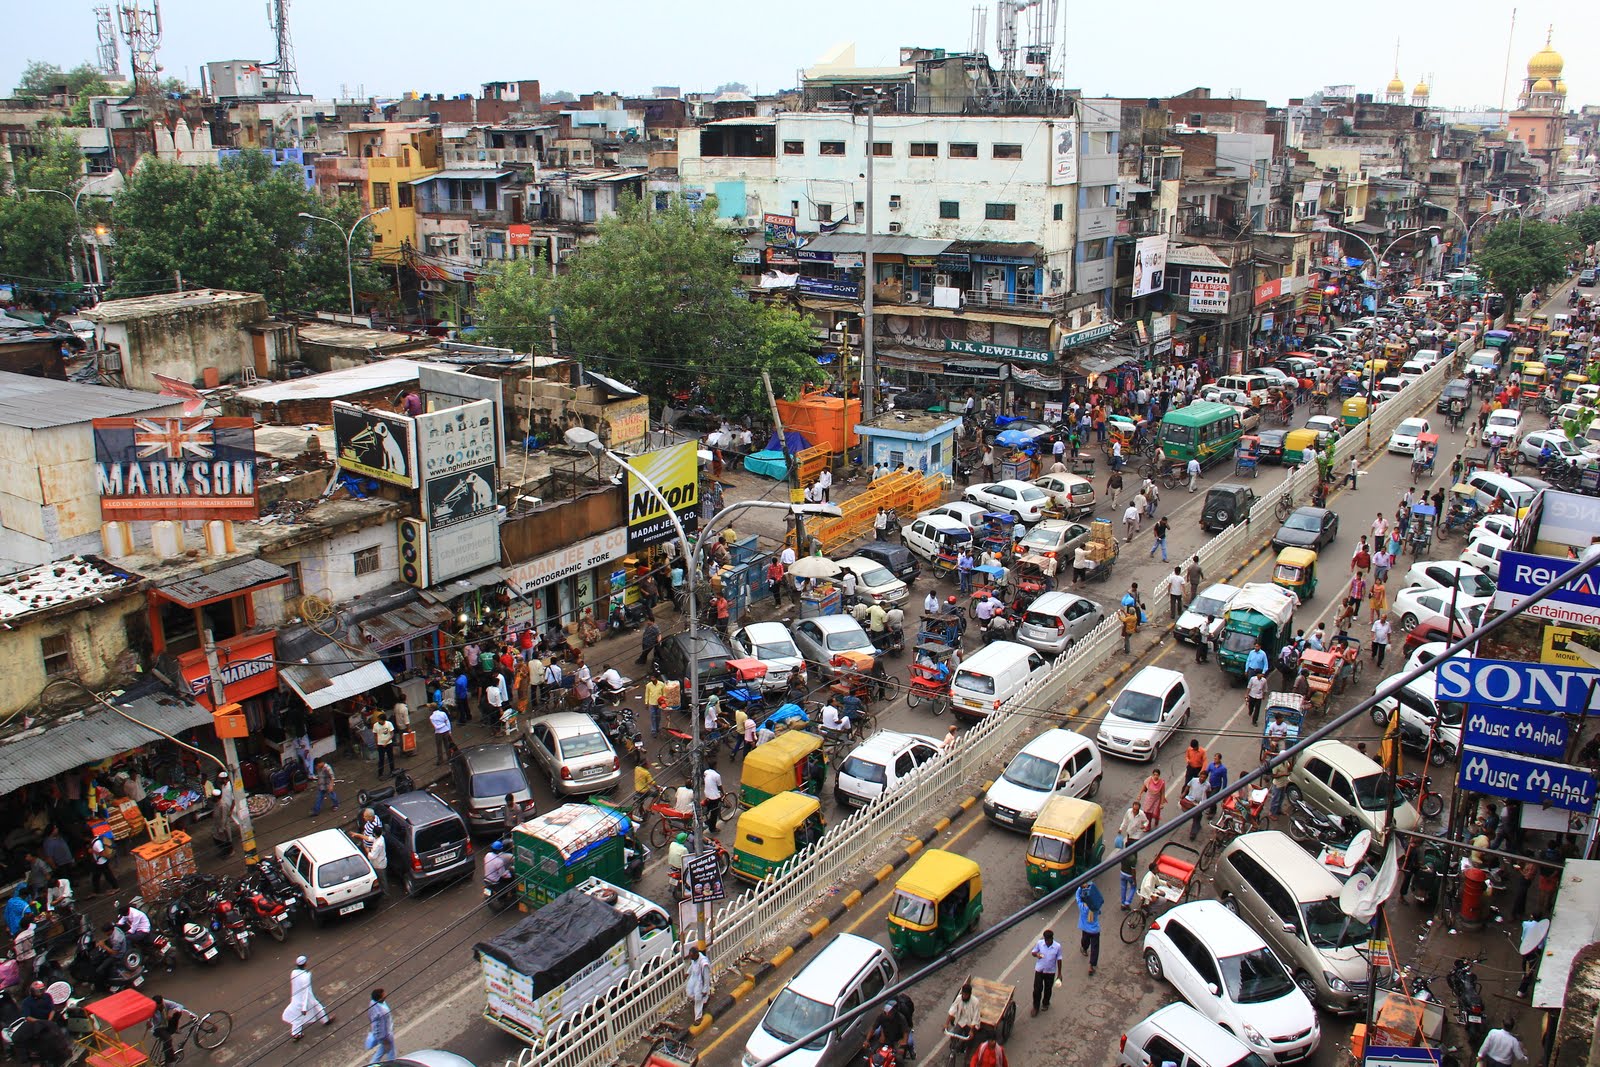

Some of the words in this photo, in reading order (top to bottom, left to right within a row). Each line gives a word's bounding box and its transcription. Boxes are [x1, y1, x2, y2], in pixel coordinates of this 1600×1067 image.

[1193, 275, 1228, 284] ALPHA
[1197, 299, 1227, 307] LIBERTY
[950, 342, 962, 351] N.
[965, 343, 977, 353] K.
[980, 344, 1048, 362] JEWELLERS
[95, 461, 254, 496] MARKSON
[429, 455, 492, 476] www.nghindia.com
[631, 481, 695, 522] Nikon
[631, 525, 659, 540] MADAN
[685, 512, 696, 522] CO.
[560, 544, 585, 568] JEE
[592, 541, 601, 553] &
[605, 533, 626, 548] CO.
[526, 562, 582, 590] PHOTOGRAPHIC
[587, 551, 610, 566] STORE
[222, 653, 273, 685] MARKSON
[1556, 652, 1580, 662] MONEY
